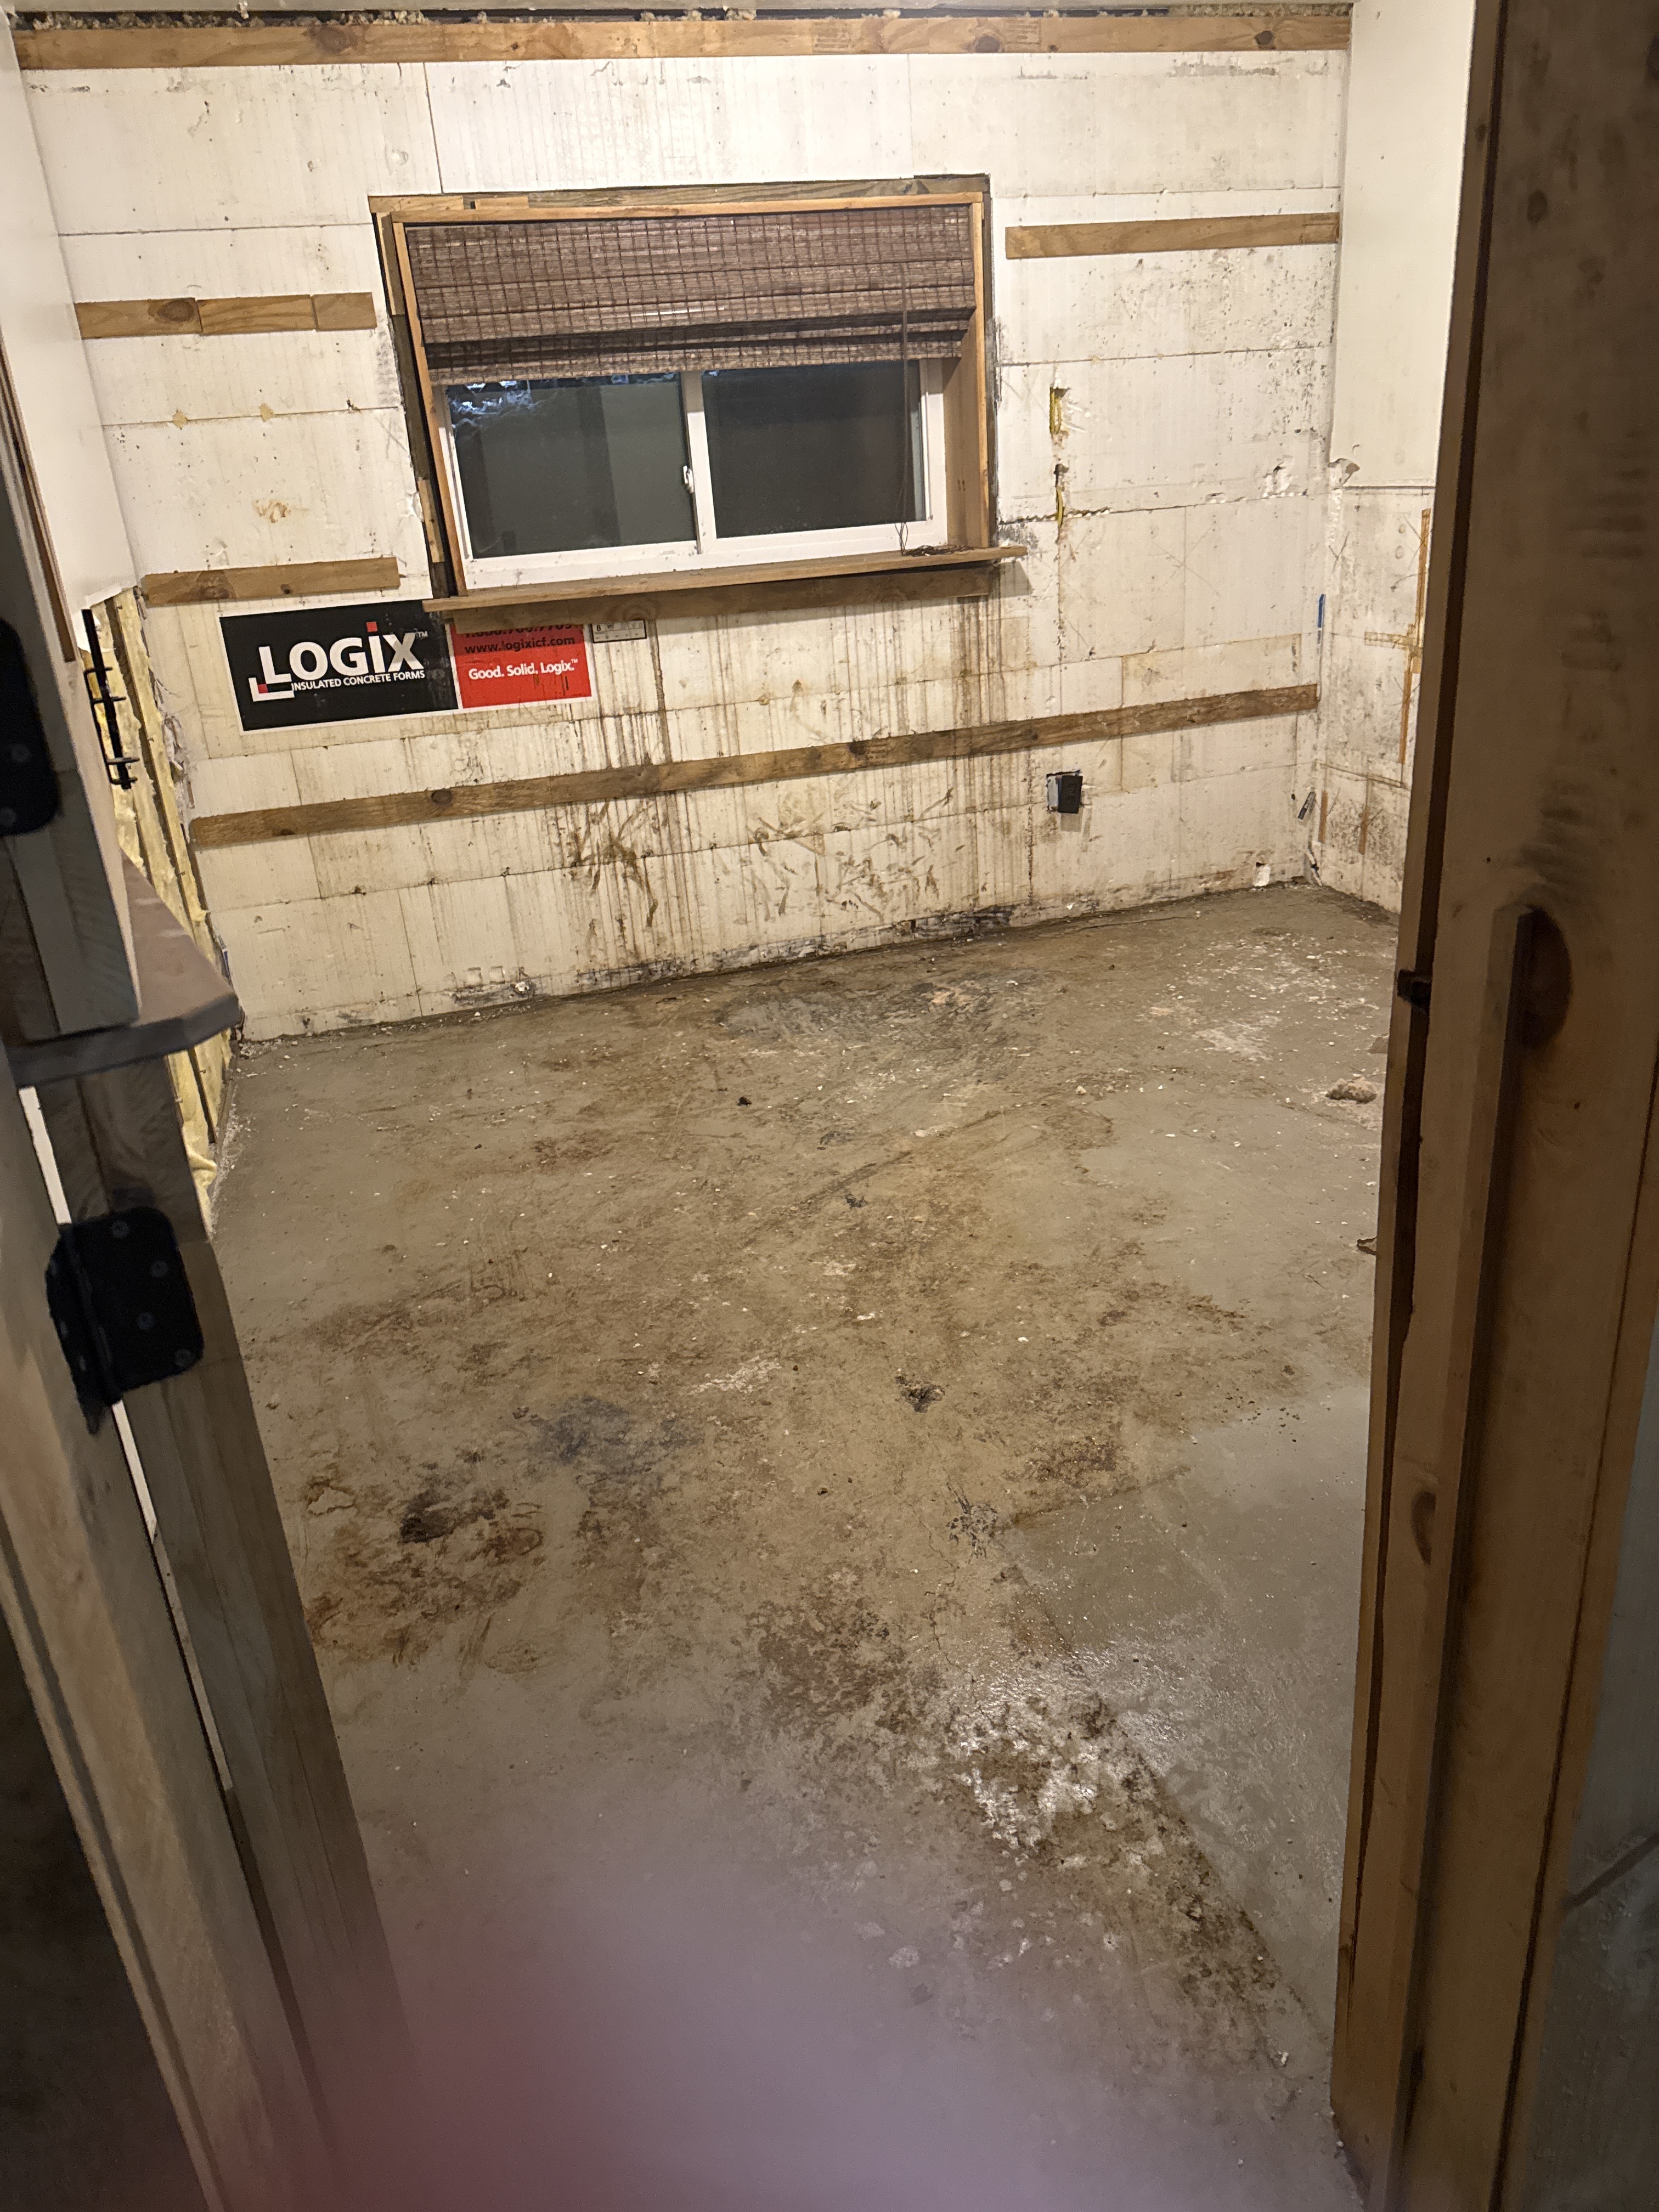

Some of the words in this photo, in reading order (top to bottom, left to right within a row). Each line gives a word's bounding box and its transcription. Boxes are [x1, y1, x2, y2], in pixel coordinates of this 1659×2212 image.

[464, 636, 575, 653] www.logixicf.com
[469, 665, 505, 680] Good.
[506, 662, 539, 676] Solid.
[291, 678, 342, 691] INSULATED
[343, 673, 392, 686] CONCRETE
[393, 670, 426, 681] FORMS
